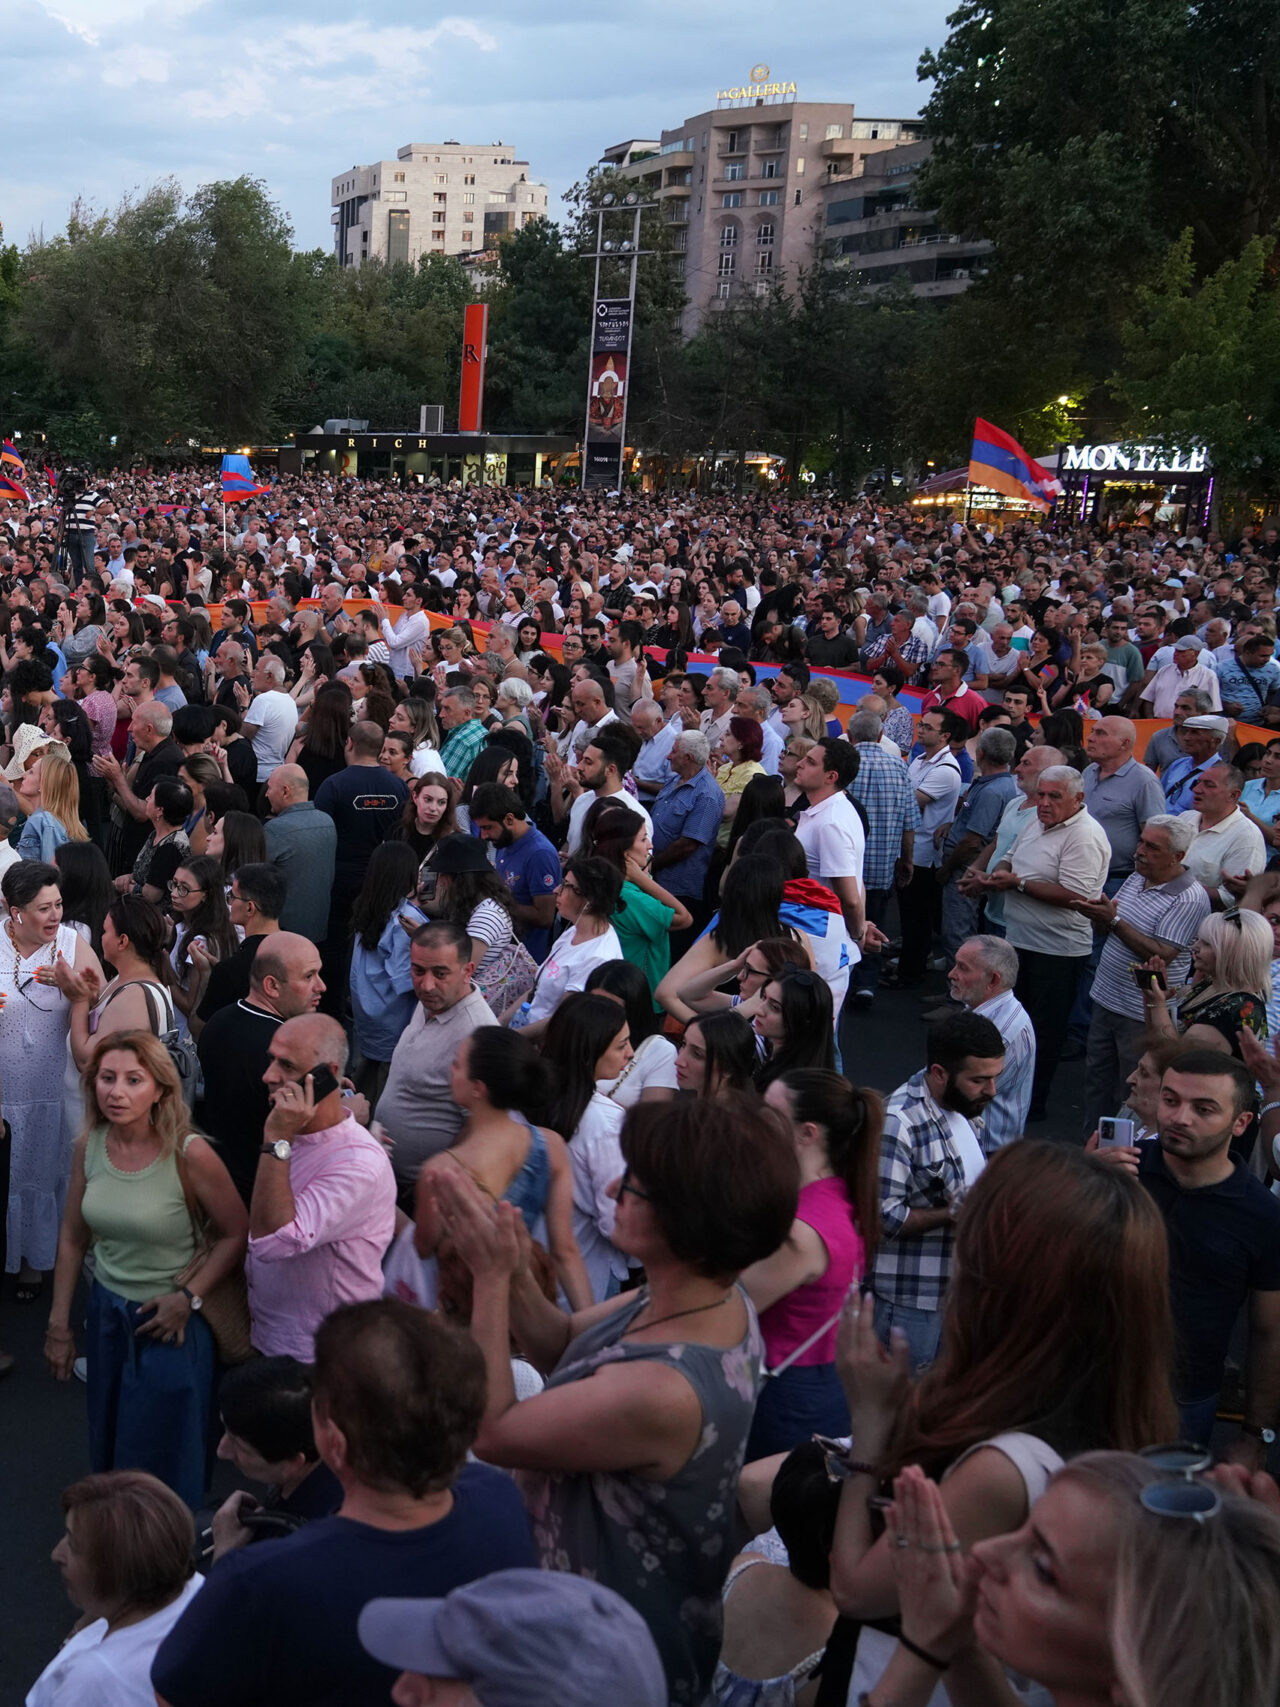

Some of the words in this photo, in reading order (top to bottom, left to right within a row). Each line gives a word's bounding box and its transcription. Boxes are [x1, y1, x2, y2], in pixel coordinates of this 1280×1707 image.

[728, 81, 797, 99] GALLERIA
[464, 344, 480, 363] R
[348, 438, 427, 448] RICH
